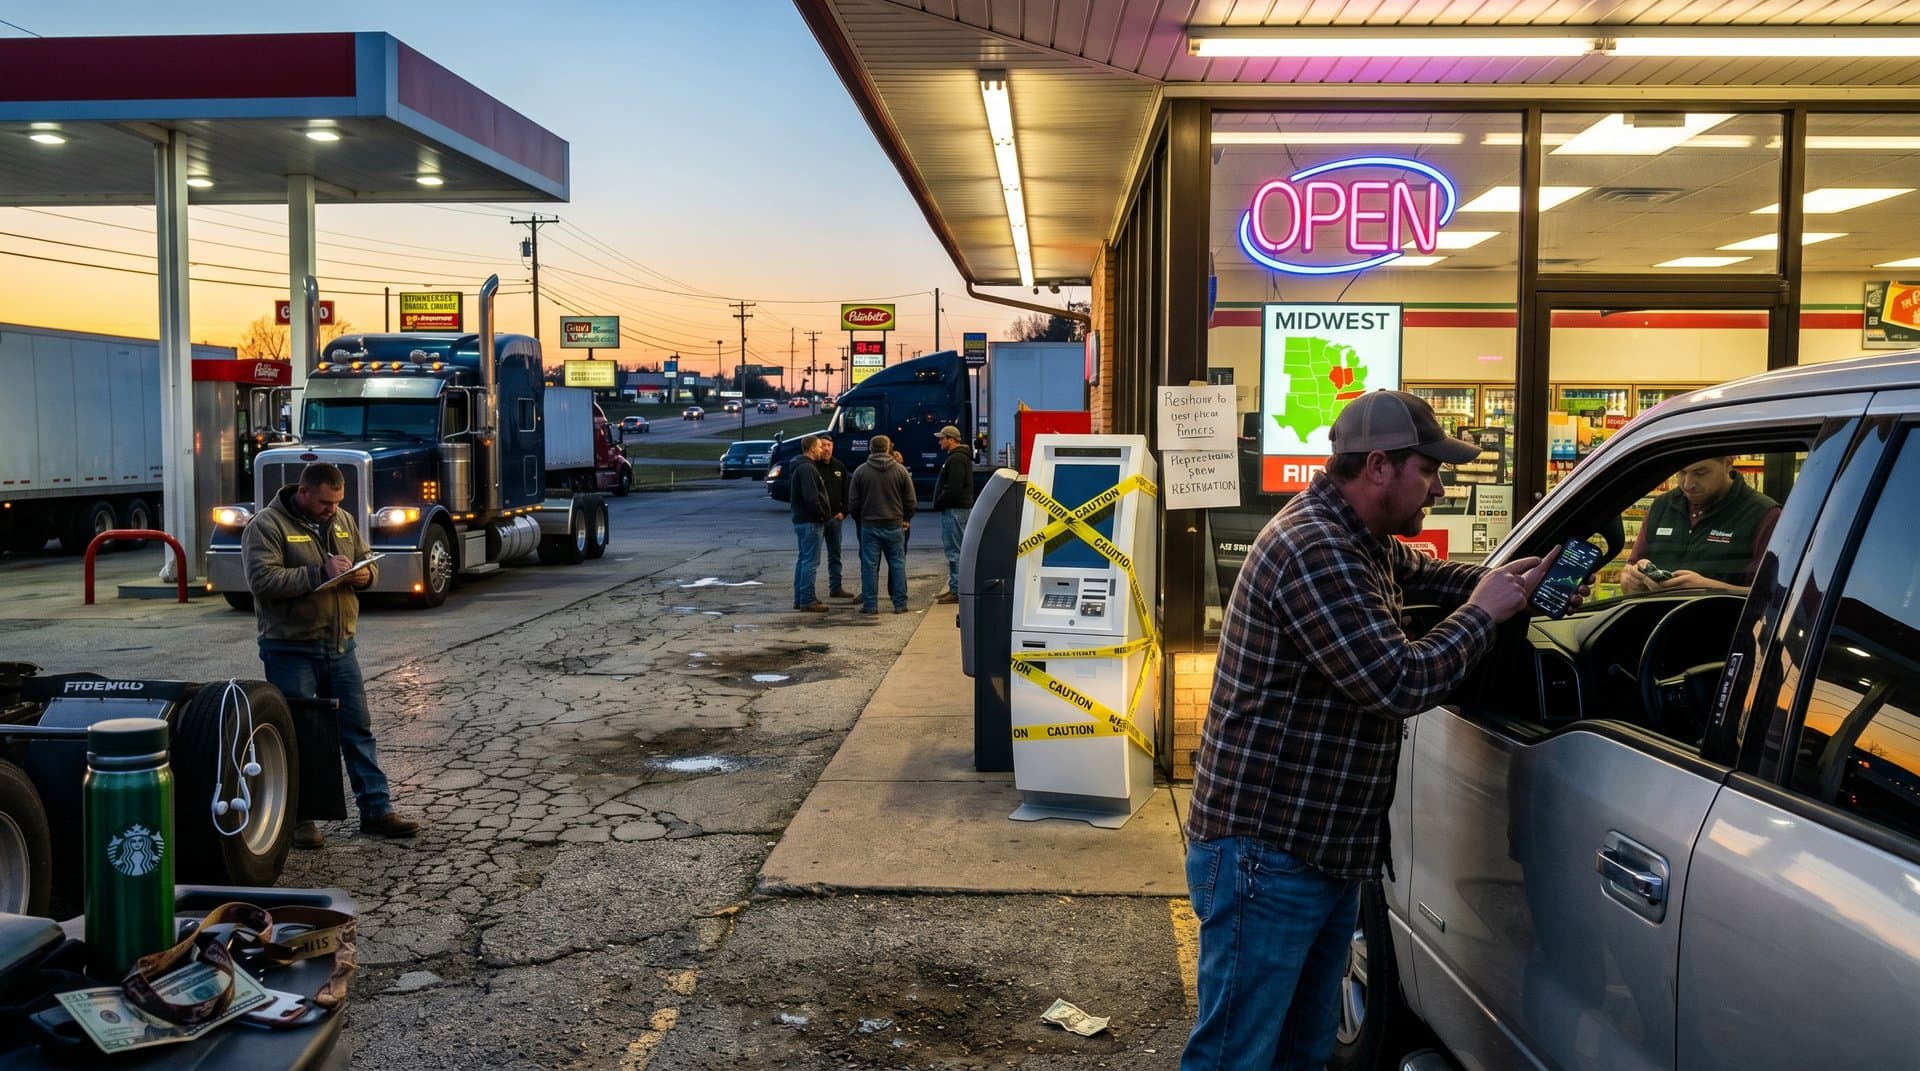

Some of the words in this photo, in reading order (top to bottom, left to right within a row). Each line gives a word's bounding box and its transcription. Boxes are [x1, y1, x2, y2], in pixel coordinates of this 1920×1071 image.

[1251, 180, 1438, 253] OPEN
[1275, 312, 1390, 331] MIDWEST
[1075, 488, 1120, 518] CAUTION
[1049, 680, 1093, 711] CAUTION
[1047, 725, 1095, 737] CAUTION
